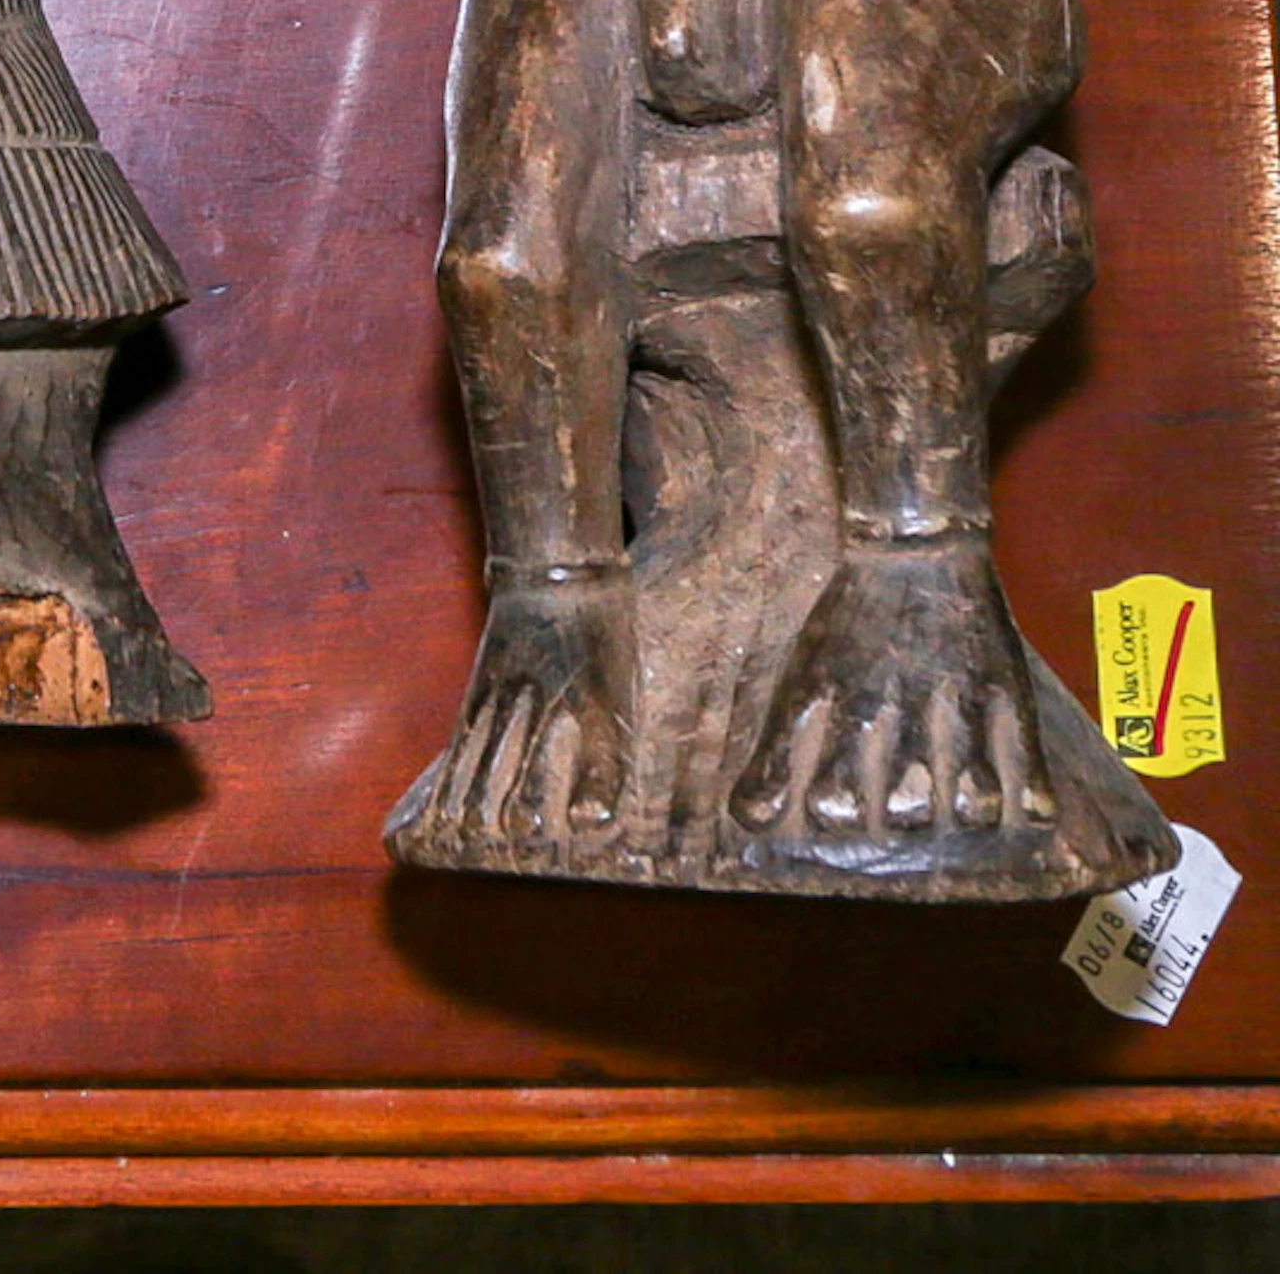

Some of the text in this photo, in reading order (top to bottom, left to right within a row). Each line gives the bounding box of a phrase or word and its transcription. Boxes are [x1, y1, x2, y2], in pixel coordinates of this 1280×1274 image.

[1112, 601, 1140, 666] Cooper
[1116, 670, 1140, 708] Alex
[1180, 692, 1220, 759] 9312
[1139, 915, 1160, 939] Alex
[1151, 875, 1180, 914] Cooper
